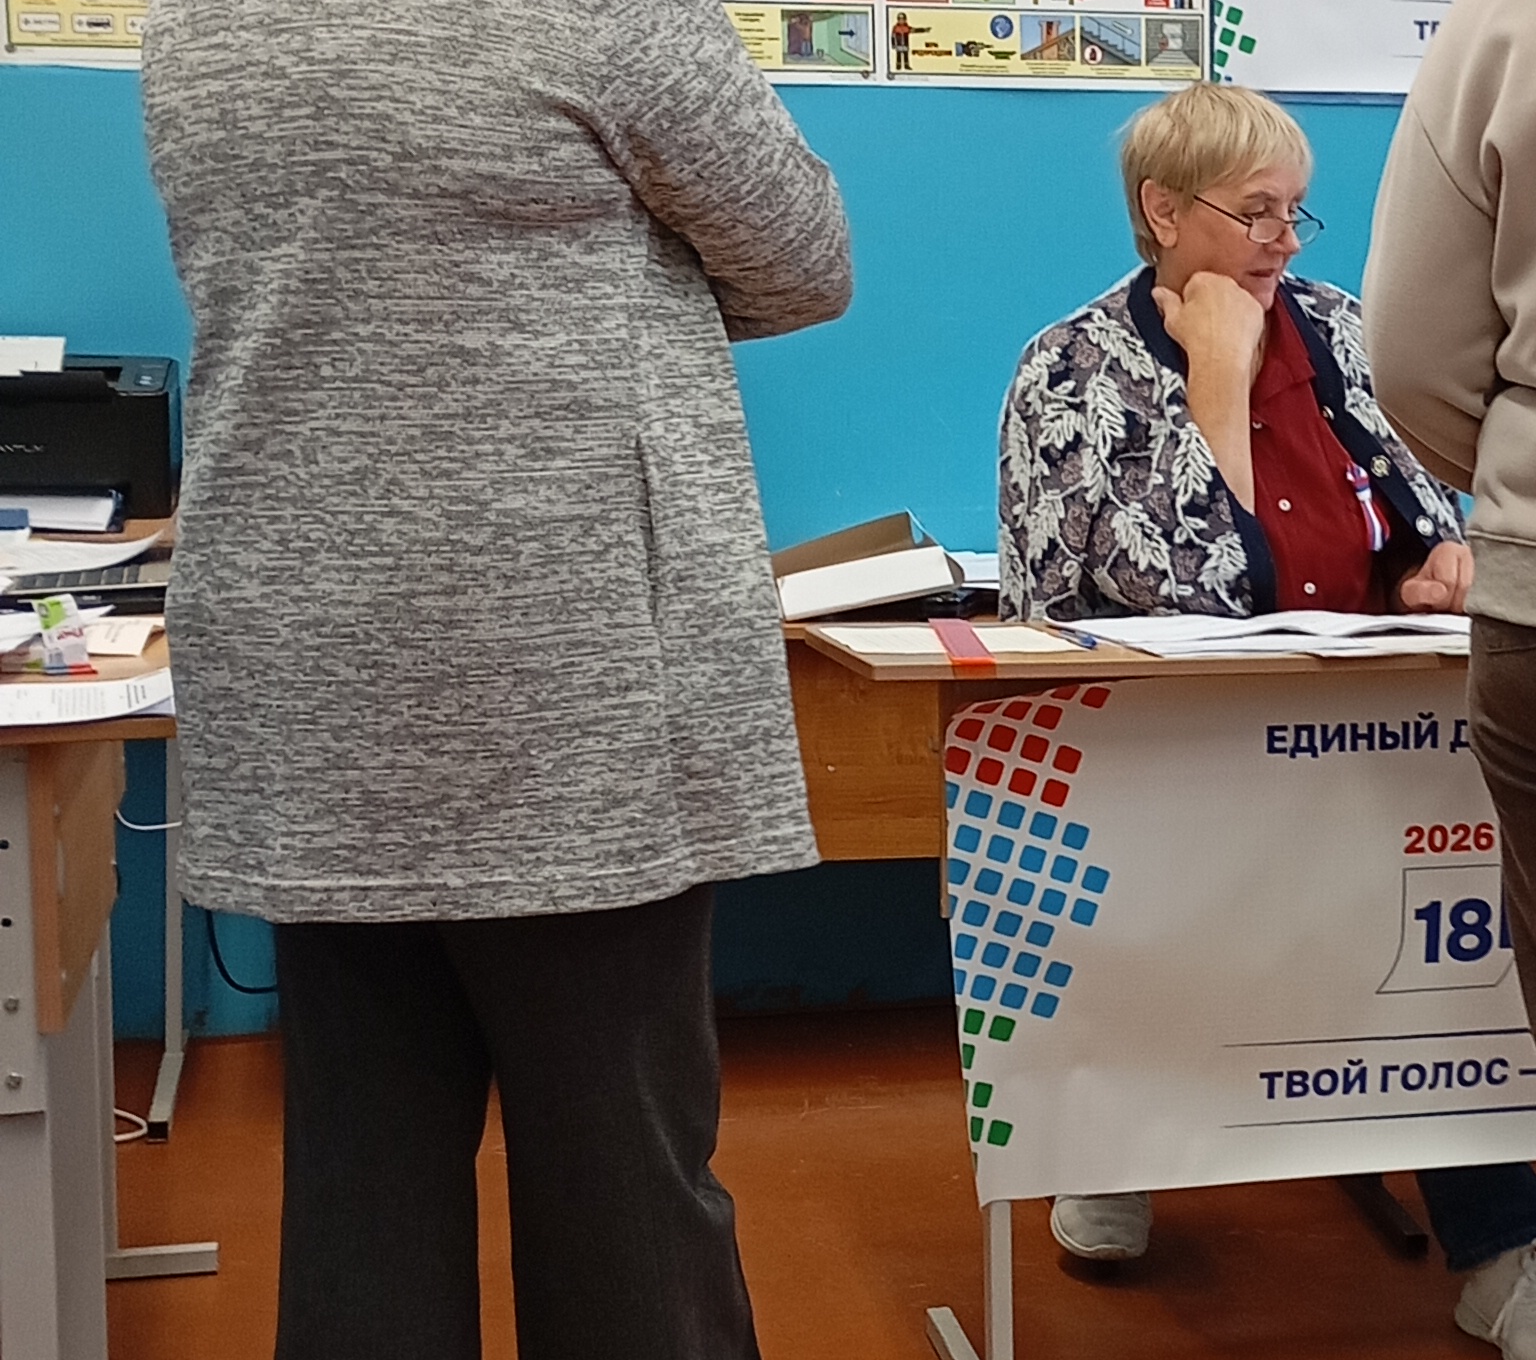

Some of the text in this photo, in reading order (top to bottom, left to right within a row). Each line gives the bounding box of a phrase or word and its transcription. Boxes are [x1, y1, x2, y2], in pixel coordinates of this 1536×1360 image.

[1266, 712, 1439, 758] ЕДИНЫЙ
[1404, 822, 1495, 854] 2026
[1414, 898, 1493, 964] 18
[1259, 1059, 1368, 1100] ТВОЙ
[1380, 1058, 1510, 1093] ГОЛОС
